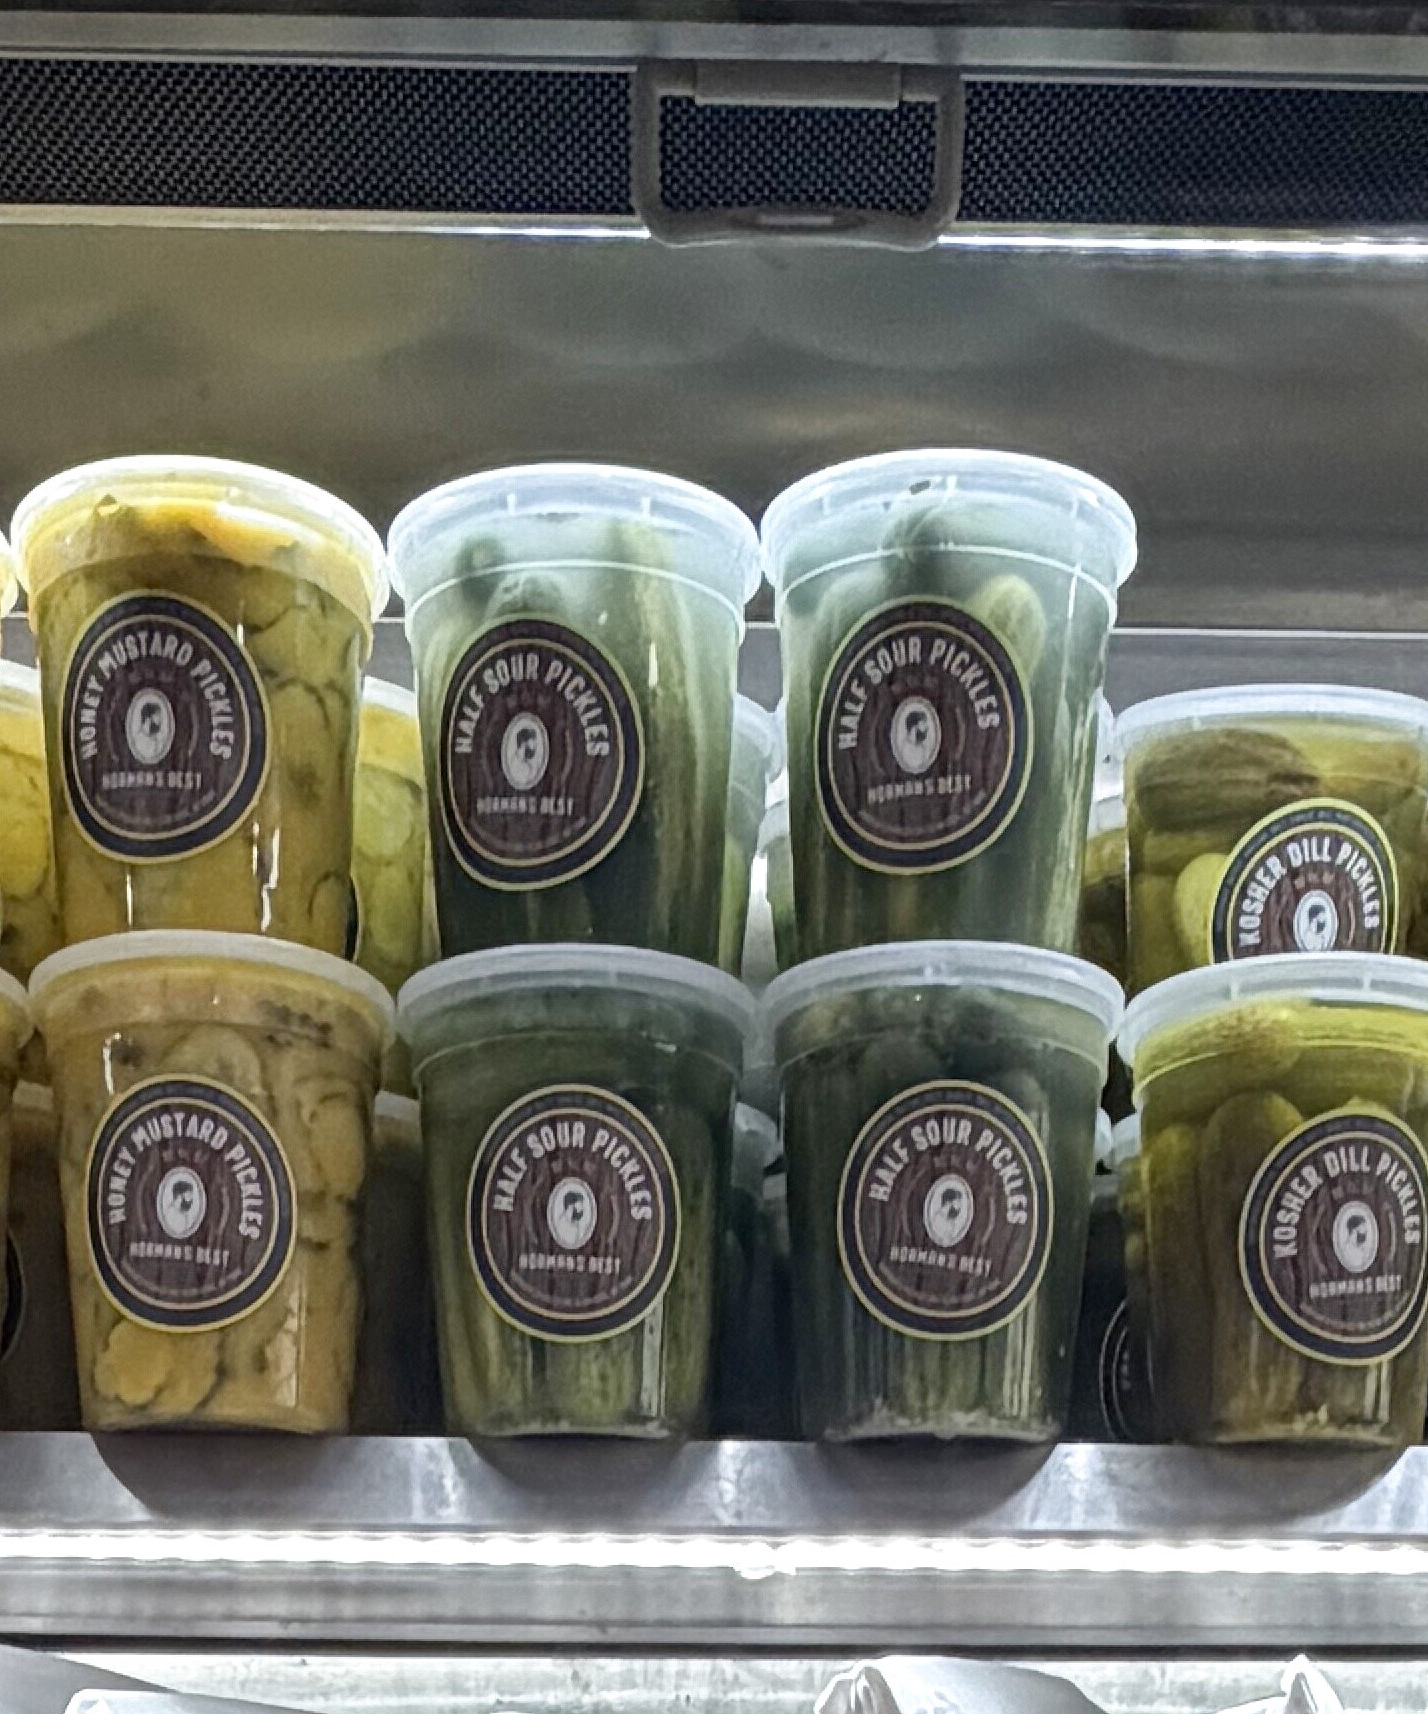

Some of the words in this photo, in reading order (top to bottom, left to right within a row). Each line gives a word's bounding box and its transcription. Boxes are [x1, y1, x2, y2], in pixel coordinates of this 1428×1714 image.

[79, 675, 103, 760] HONEY
[98, 630, 193, 680] MUSTARD
[190, 659, 234, 760] PICKLES
[454, 684, 484, 754] HALF
[483, 652, 540, 694] SOUR
[544, 659, 610, 757] PICKLES
[838, 679, 867, 750] HALF
[864, 636, 921, 684] SOUR
[930, 638, 1000, 730] PICKLES
[1238, 854, 1287, 947] KOSHER
[1286, 836, 1332, 868] DILL
[1335, 840, 1381, 930] PICKLES
[107, 1146, 135, 1225] HONEY
[131, 1113, 228, 1152] MUSTARD
[224, 1141, 263, 1240] PICKLES
[492, 1148, 528, 1211] HALF
[526, 1121, 586, 1158] SOUR
[591, 1128, 652, 1220] PICKLES
[868, 1138, 910, 1202] HALF
[910, 1117, 972, 1151] SOUR
[974, 1128, 1028, 1225] PICKLES
[1272, 1164, 1323, 1259] KOSHER
[1323, 1145, 1371, 1177] DILL
[1375, 1152, 1421, 1244] PICKLES
